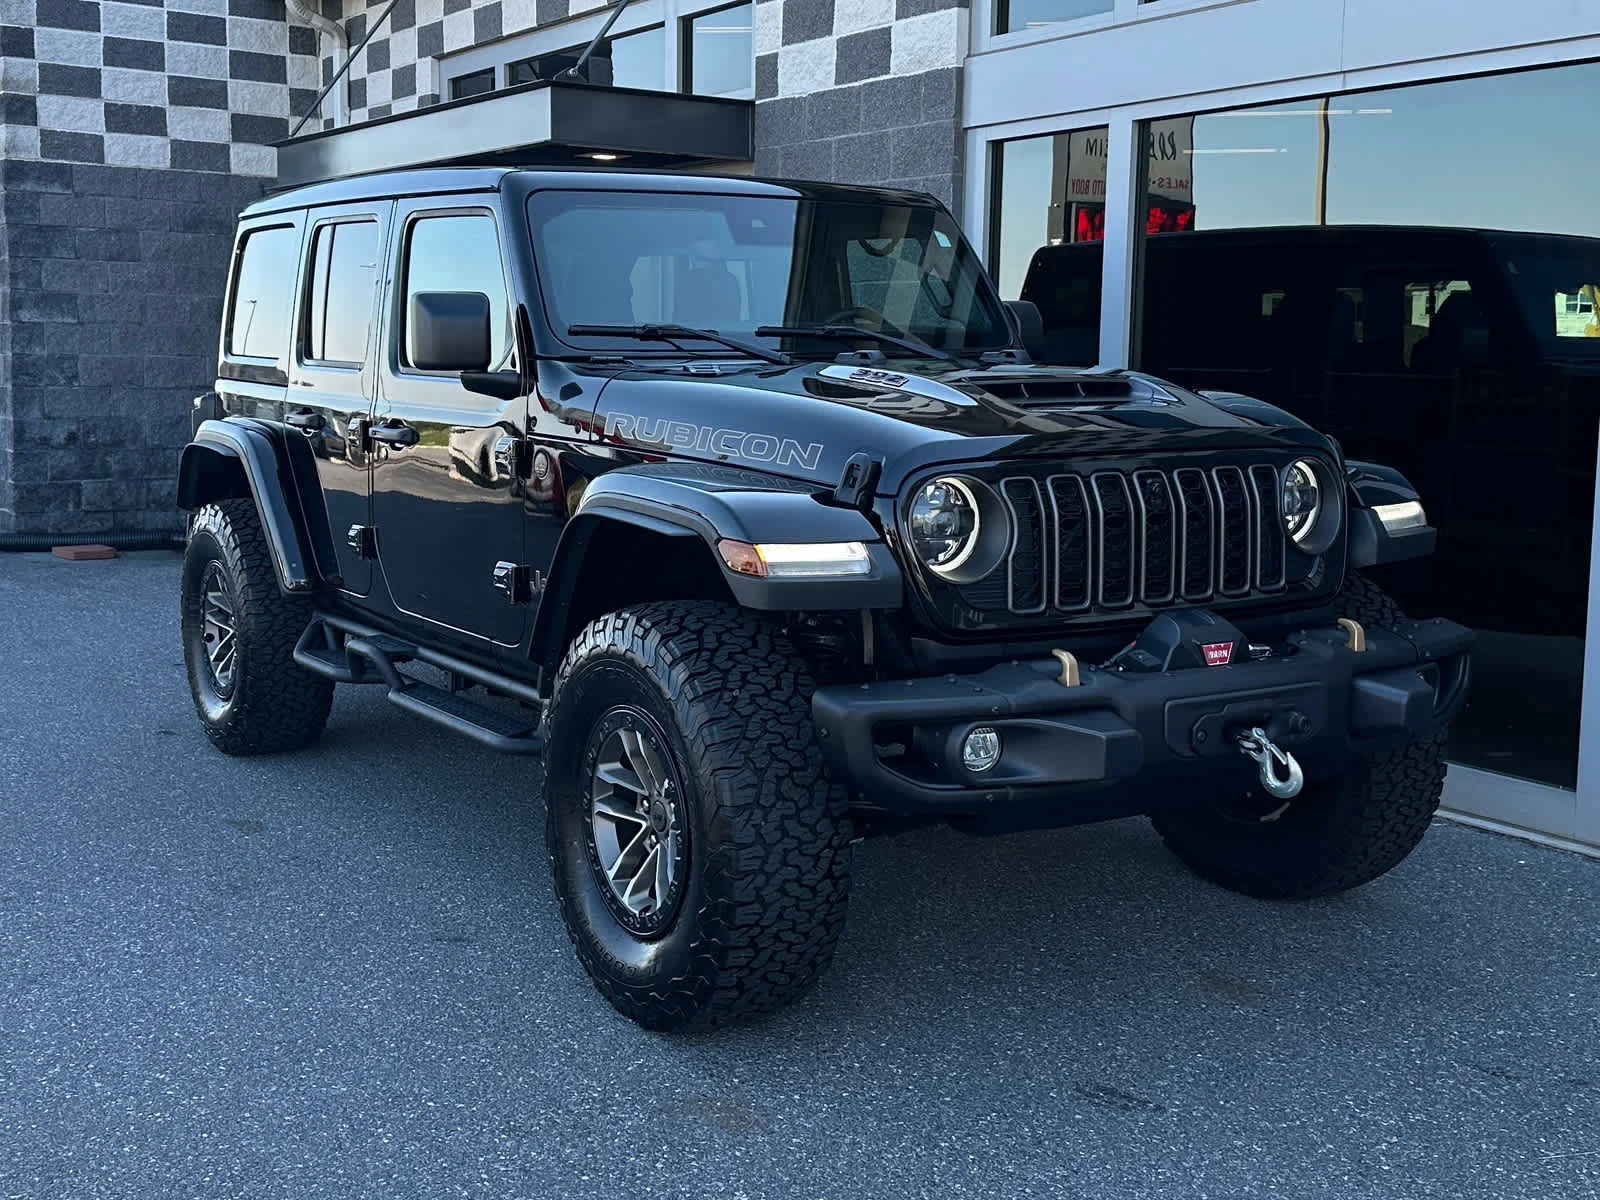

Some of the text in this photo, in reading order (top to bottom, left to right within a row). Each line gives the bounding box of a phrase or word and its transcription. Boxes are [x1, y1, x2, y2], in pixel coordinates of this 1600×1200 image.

[850, 368, 909, 388] 392
[604, 411, 824, 470] RUBICON
[1208, 650, 1228, 659] WARN
